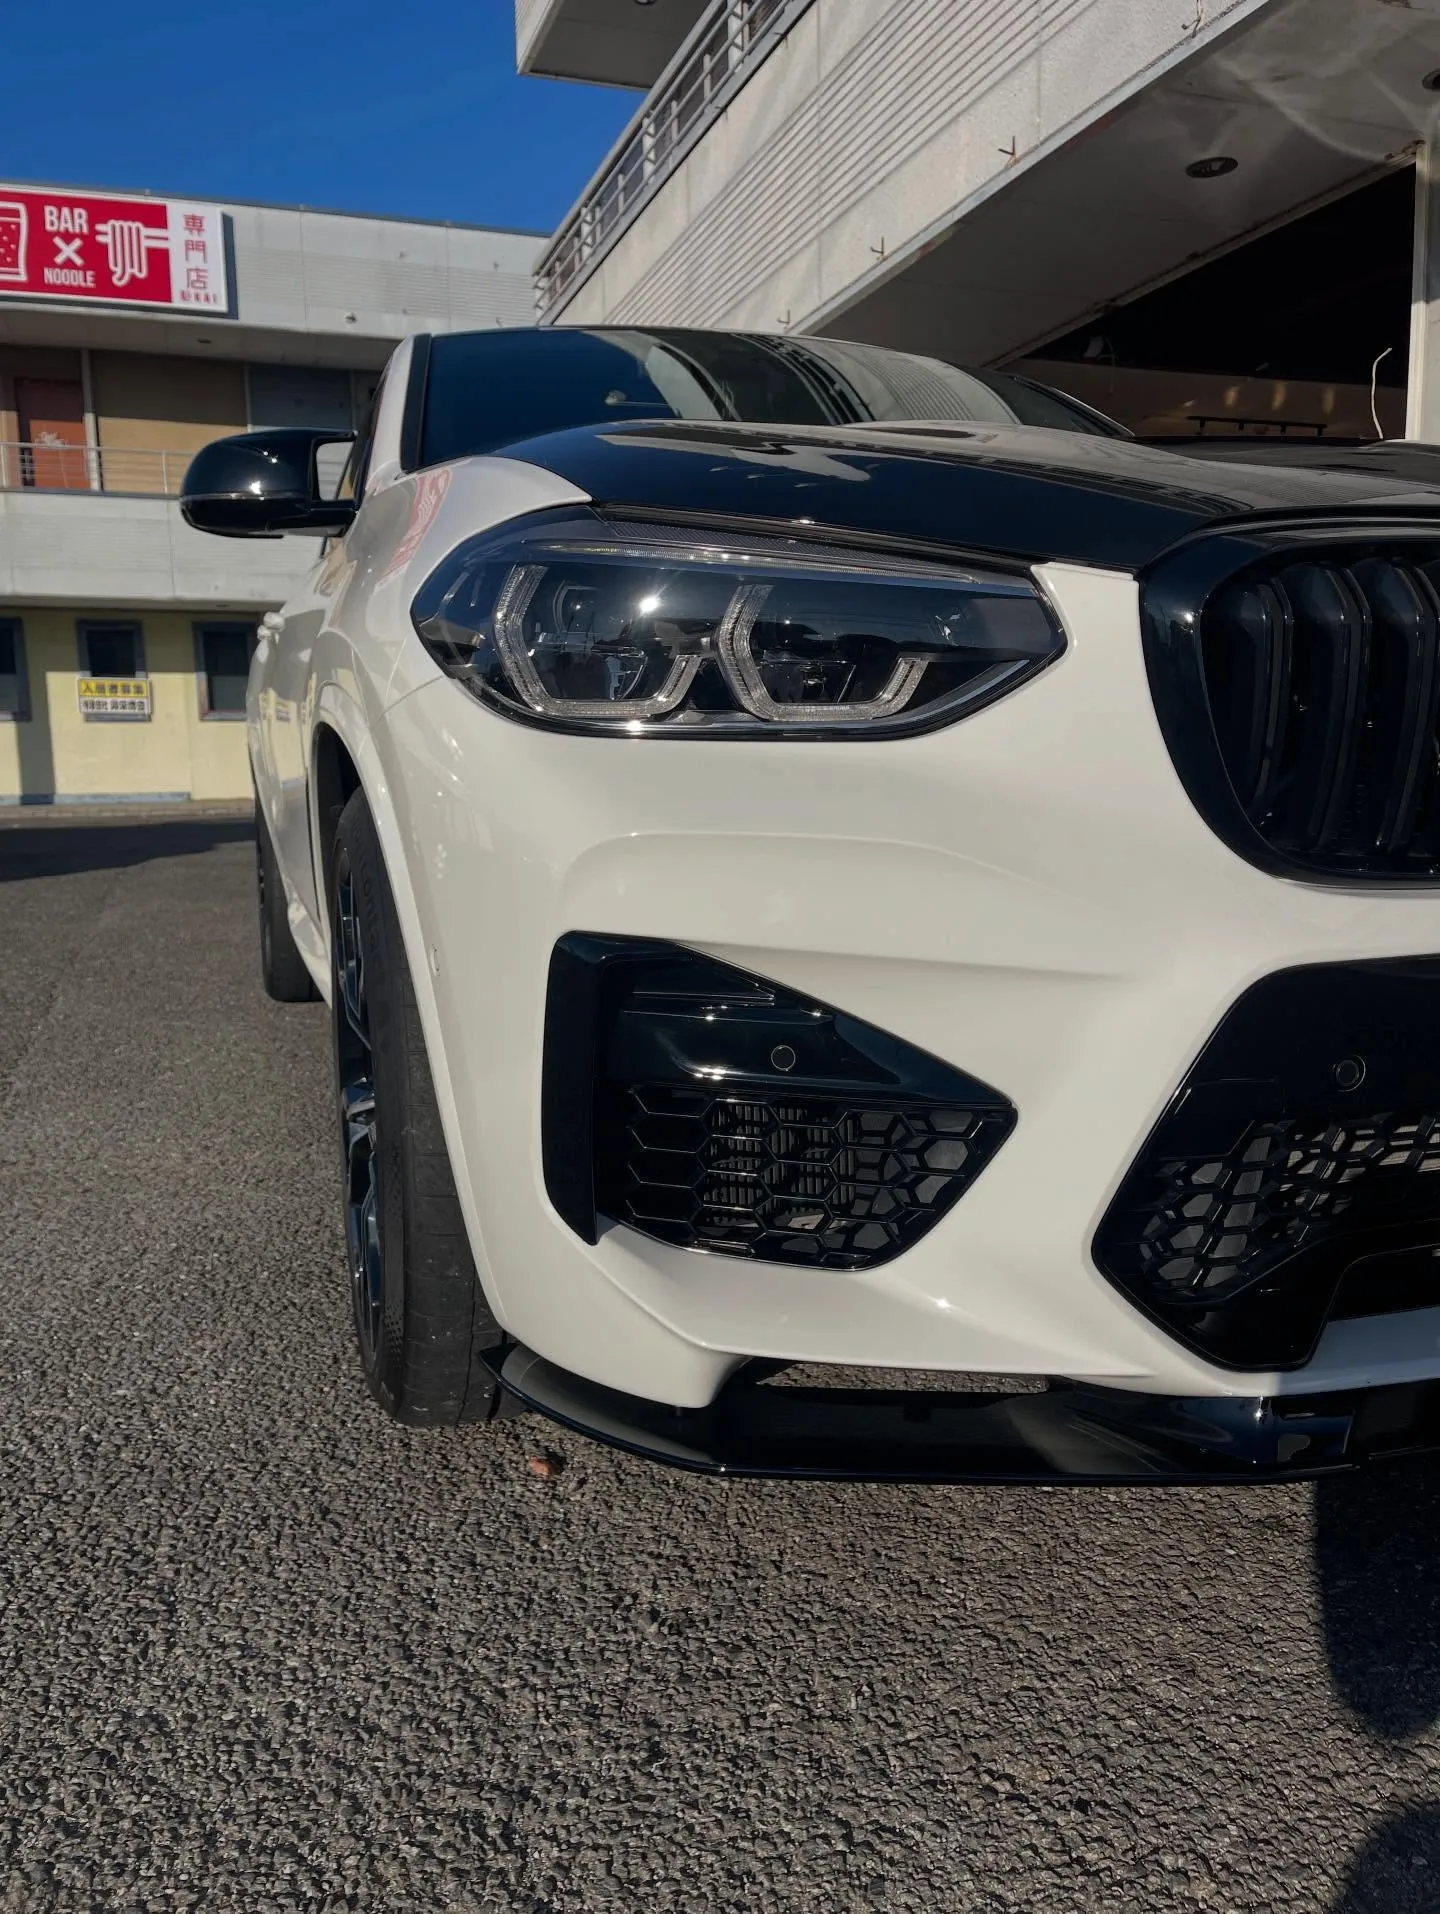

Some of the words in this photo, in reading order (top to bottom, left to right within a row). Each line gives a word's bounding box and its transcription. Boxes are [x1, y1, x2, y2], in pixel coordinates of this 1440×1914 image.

[44, 205, 89, 235] BAR
[183, 213, 209, 290] 専門店
[43, 267, 96, 288] NOODLE
